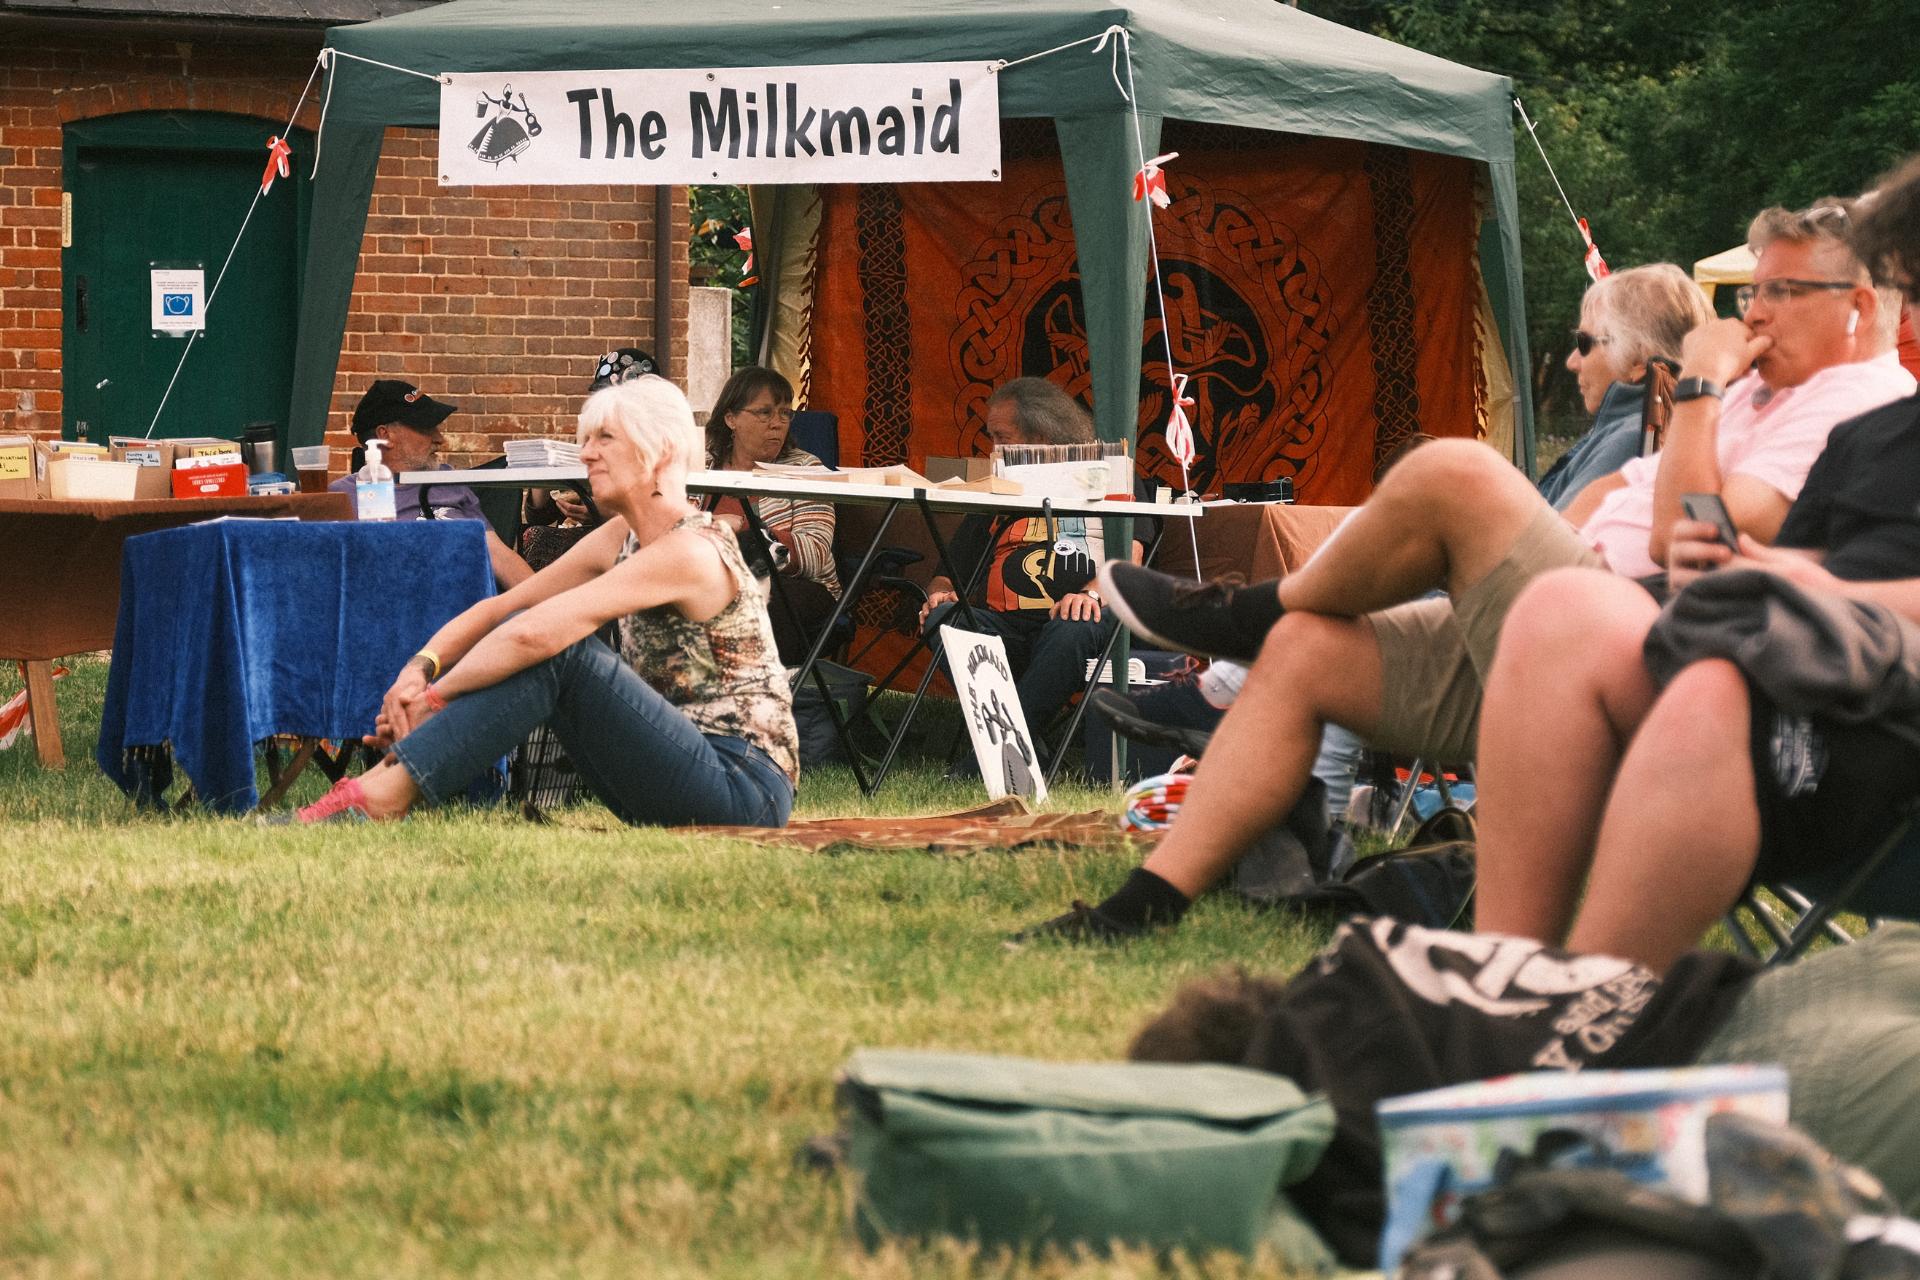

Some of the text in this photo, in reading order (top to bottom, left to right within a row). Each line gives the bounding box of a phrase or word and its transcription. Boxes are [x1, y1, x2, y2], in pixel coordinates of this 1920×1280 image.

[567, 78, 962, 160] The Milkmaid
[967, 644, 1008, 682] MILKMAID
